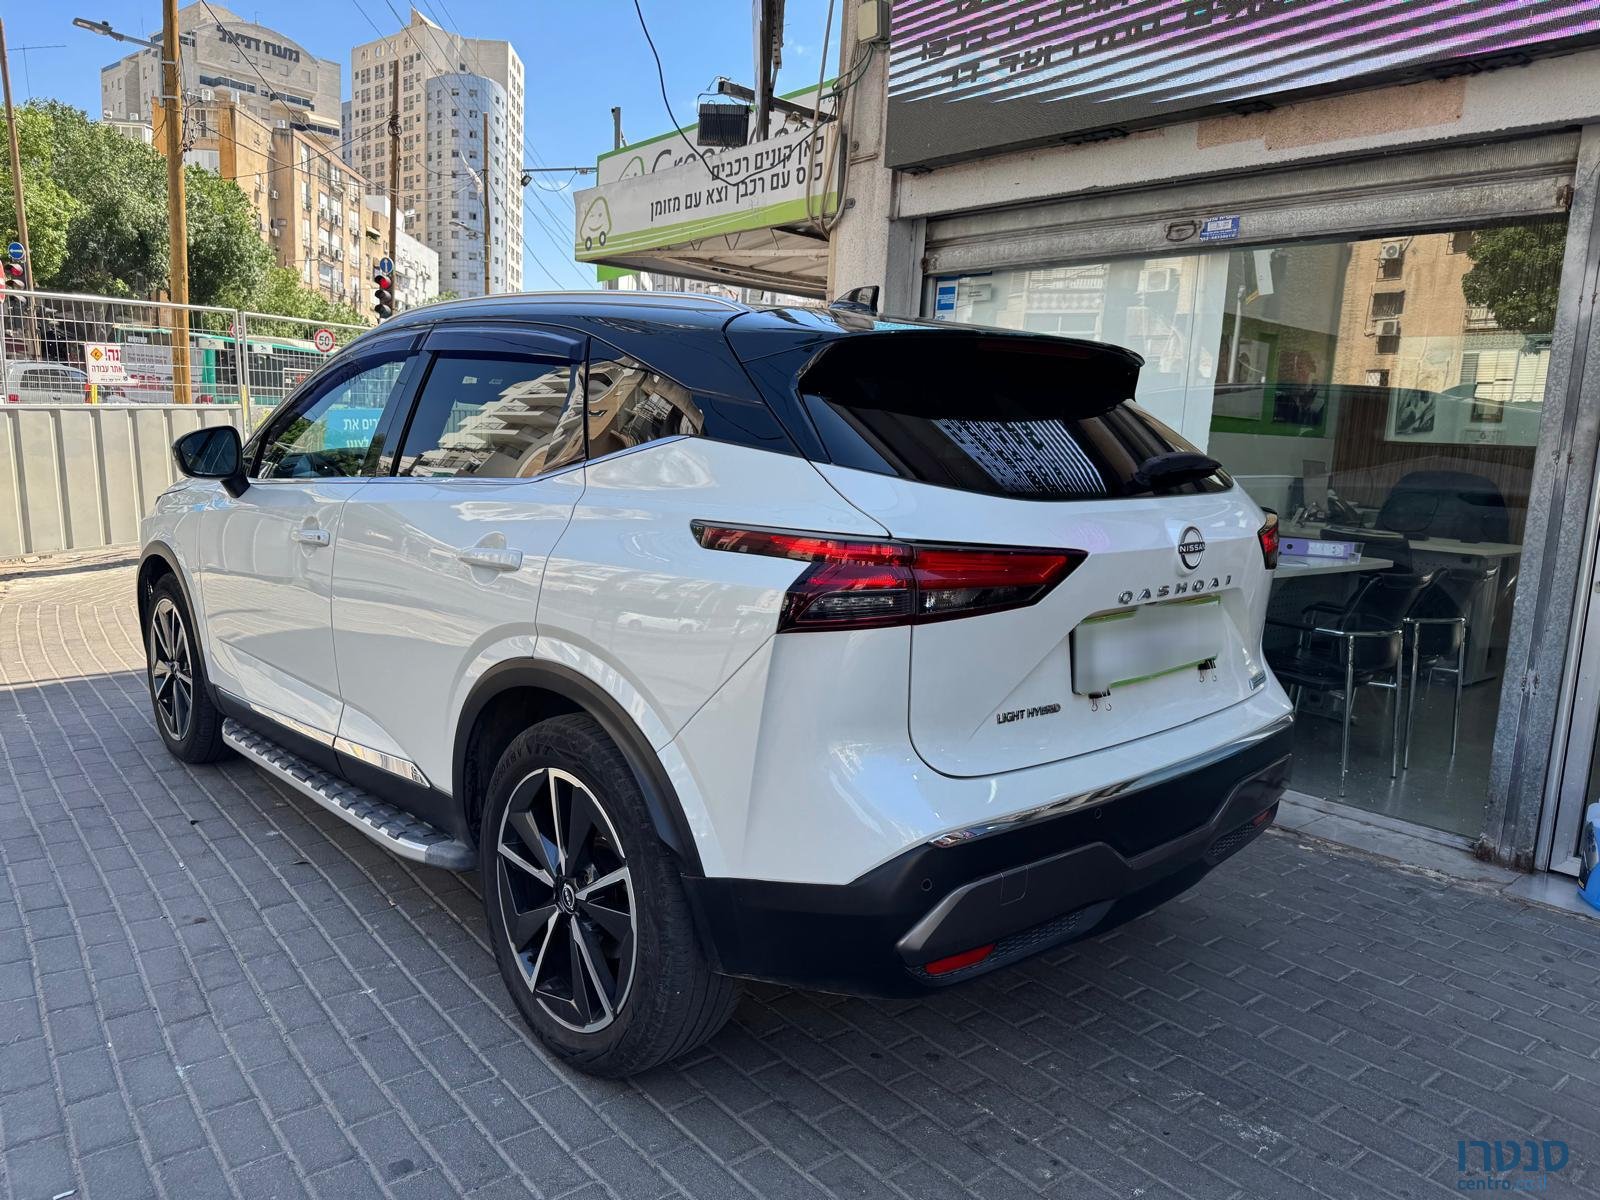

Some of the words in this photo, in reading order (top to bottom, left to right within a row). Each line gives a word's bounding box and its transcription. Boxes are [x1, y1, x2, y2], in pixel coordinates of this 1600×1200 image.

[754, 144, 792, 169] קונים
[711, 158, 749, 181] רכבים
[796, 163, 823, 185] כס
[770, 170, 791, 191] עם
[685, 190, 702, 208] עם
[706, 184, 728, 205] וצא
[650, 195, 681, 222] מזומן
[318, 335, 330, 347] 50
[91, 364, 109, 373] עבודה
[109, 365, 123, 373] אתר
[343, 418, 360, 430] את
[1117, 575, 1232, 604] QASHQAI
[996, 709, 1026, 725] LIGHT
[1027, 703, 1061, 718] HYBRID
